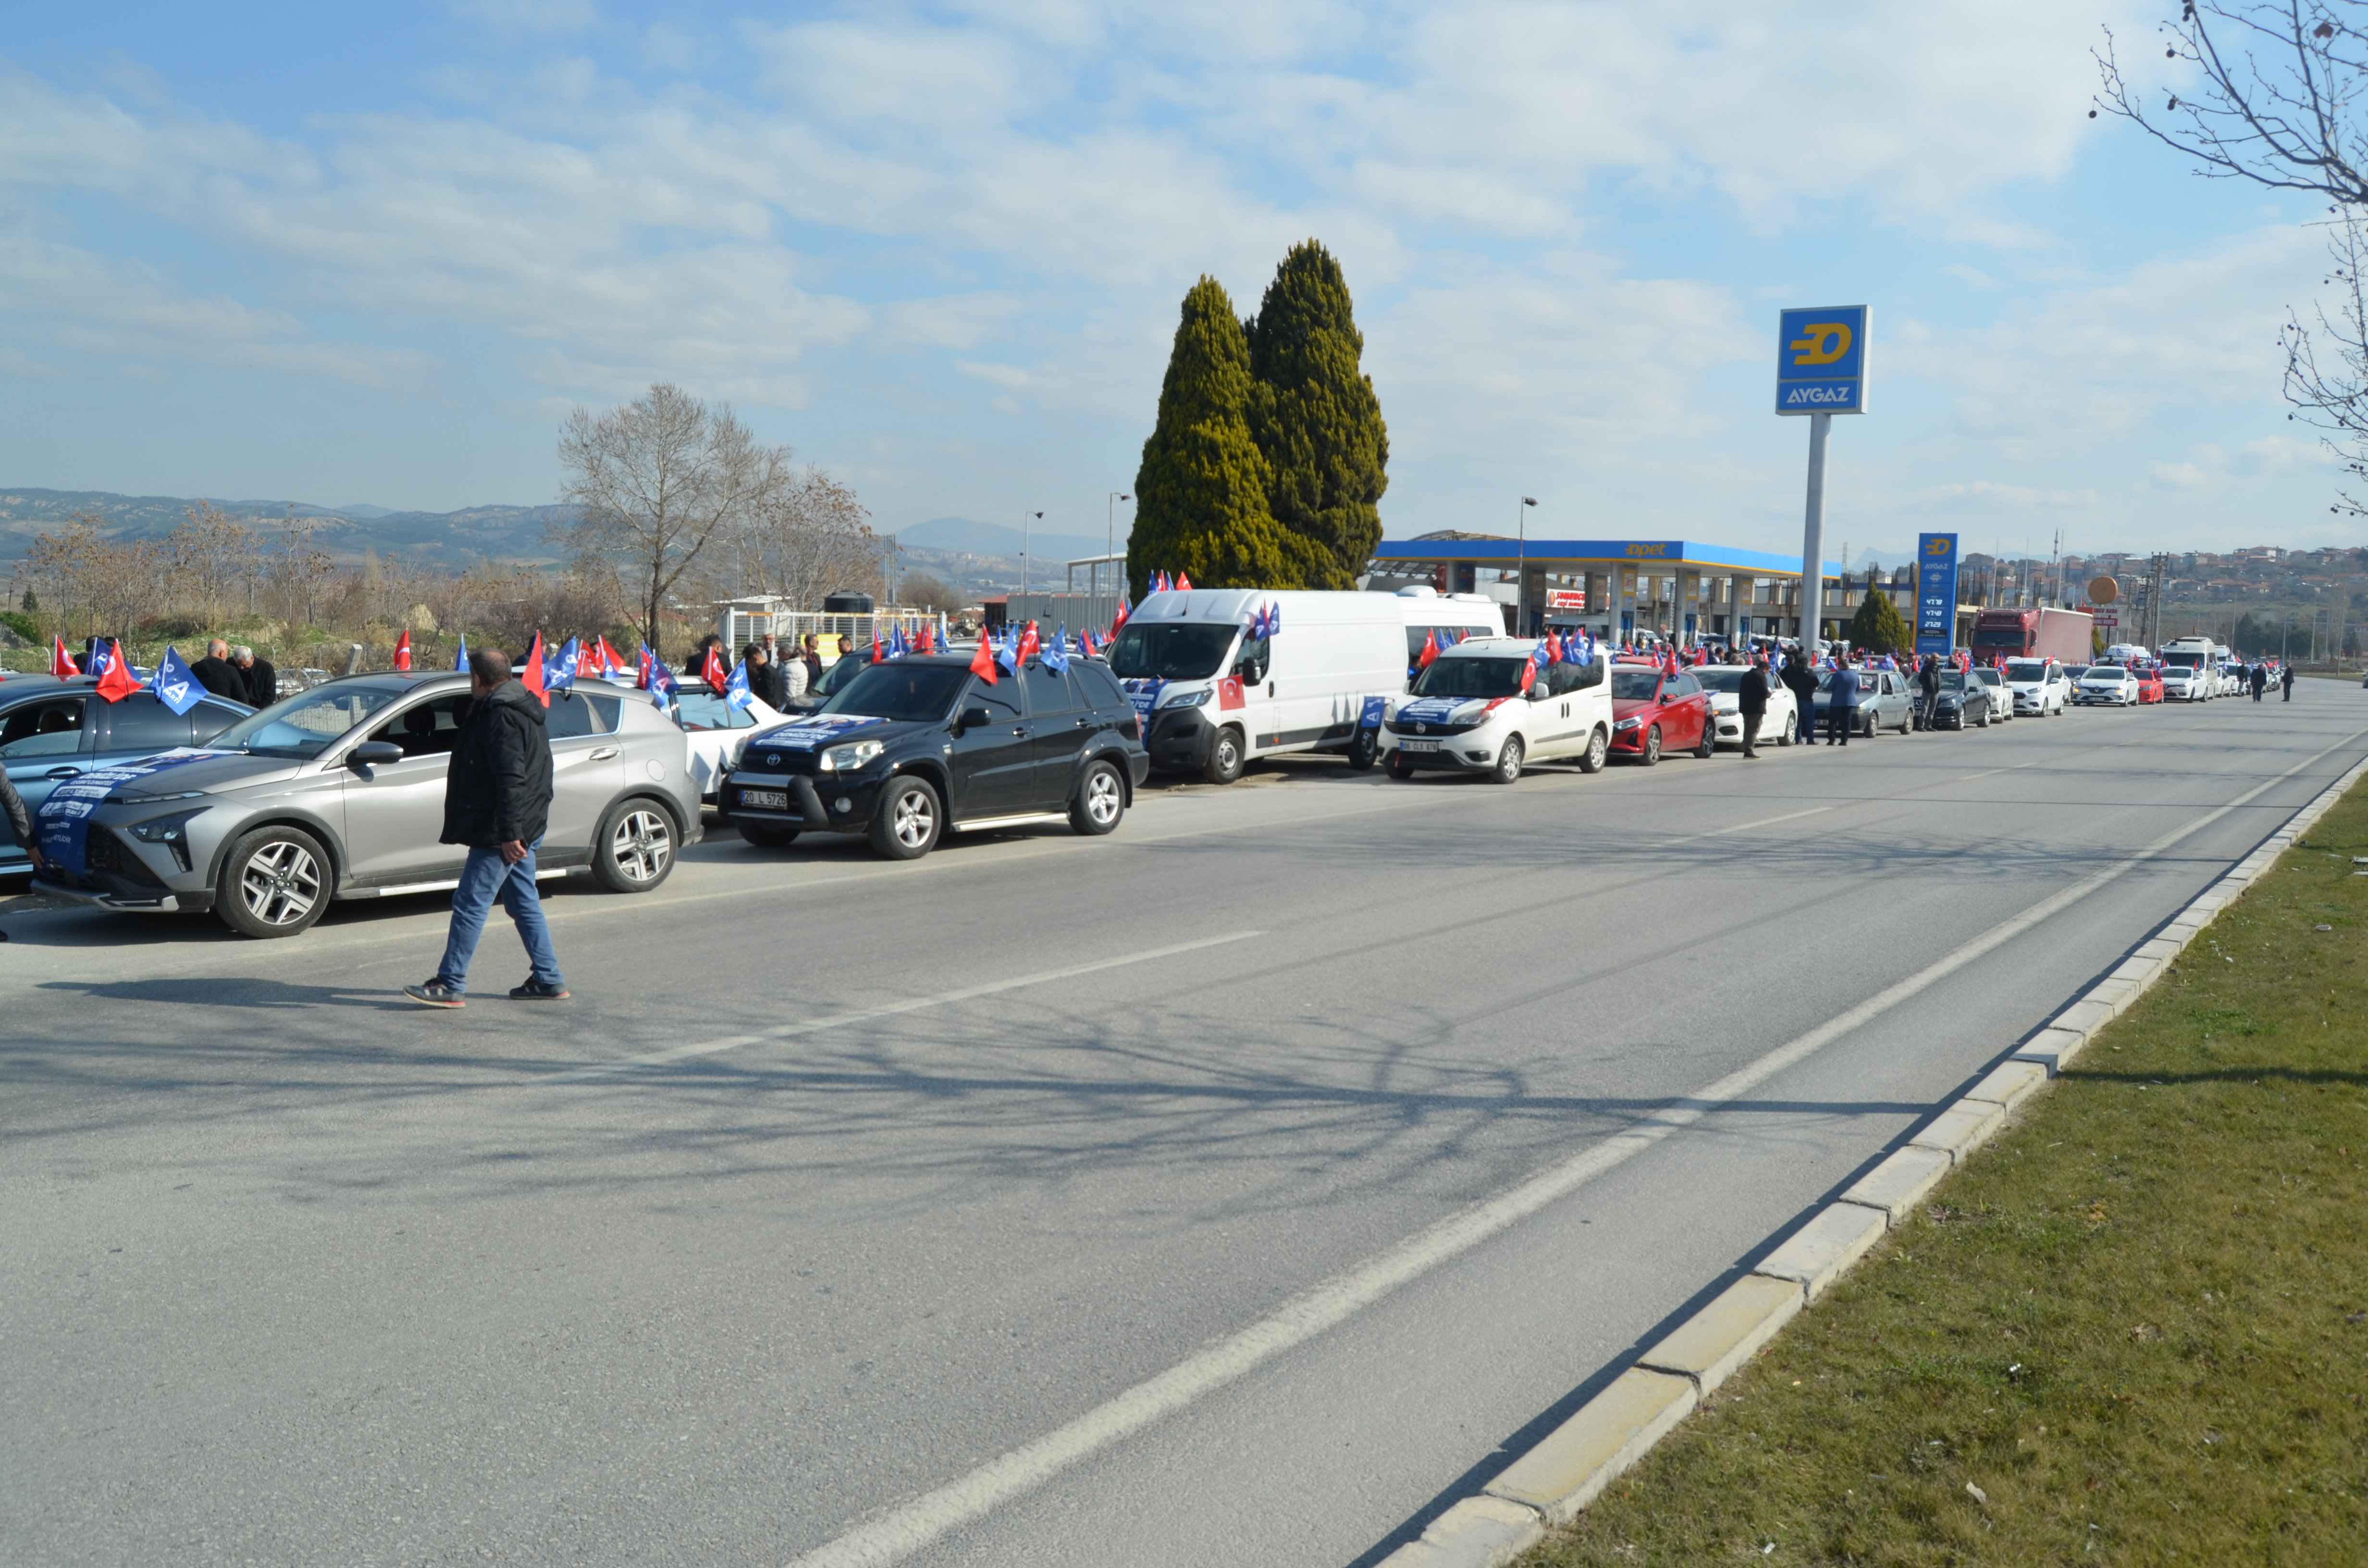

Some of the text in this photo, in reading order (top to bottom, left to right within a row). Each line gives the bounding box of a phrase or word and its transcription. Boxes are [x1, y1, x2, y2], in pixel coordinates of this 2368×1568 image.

[1787, 387, 1850, 403] AYGAZ
[1625, 543, 1667, 557] opet
[163, 688, 180, 704] PARTİ
[168, 681, 190, 700] A
[1366, 712, 1377, 722] A
[745, 792, 786, 805] 20 L 5726
